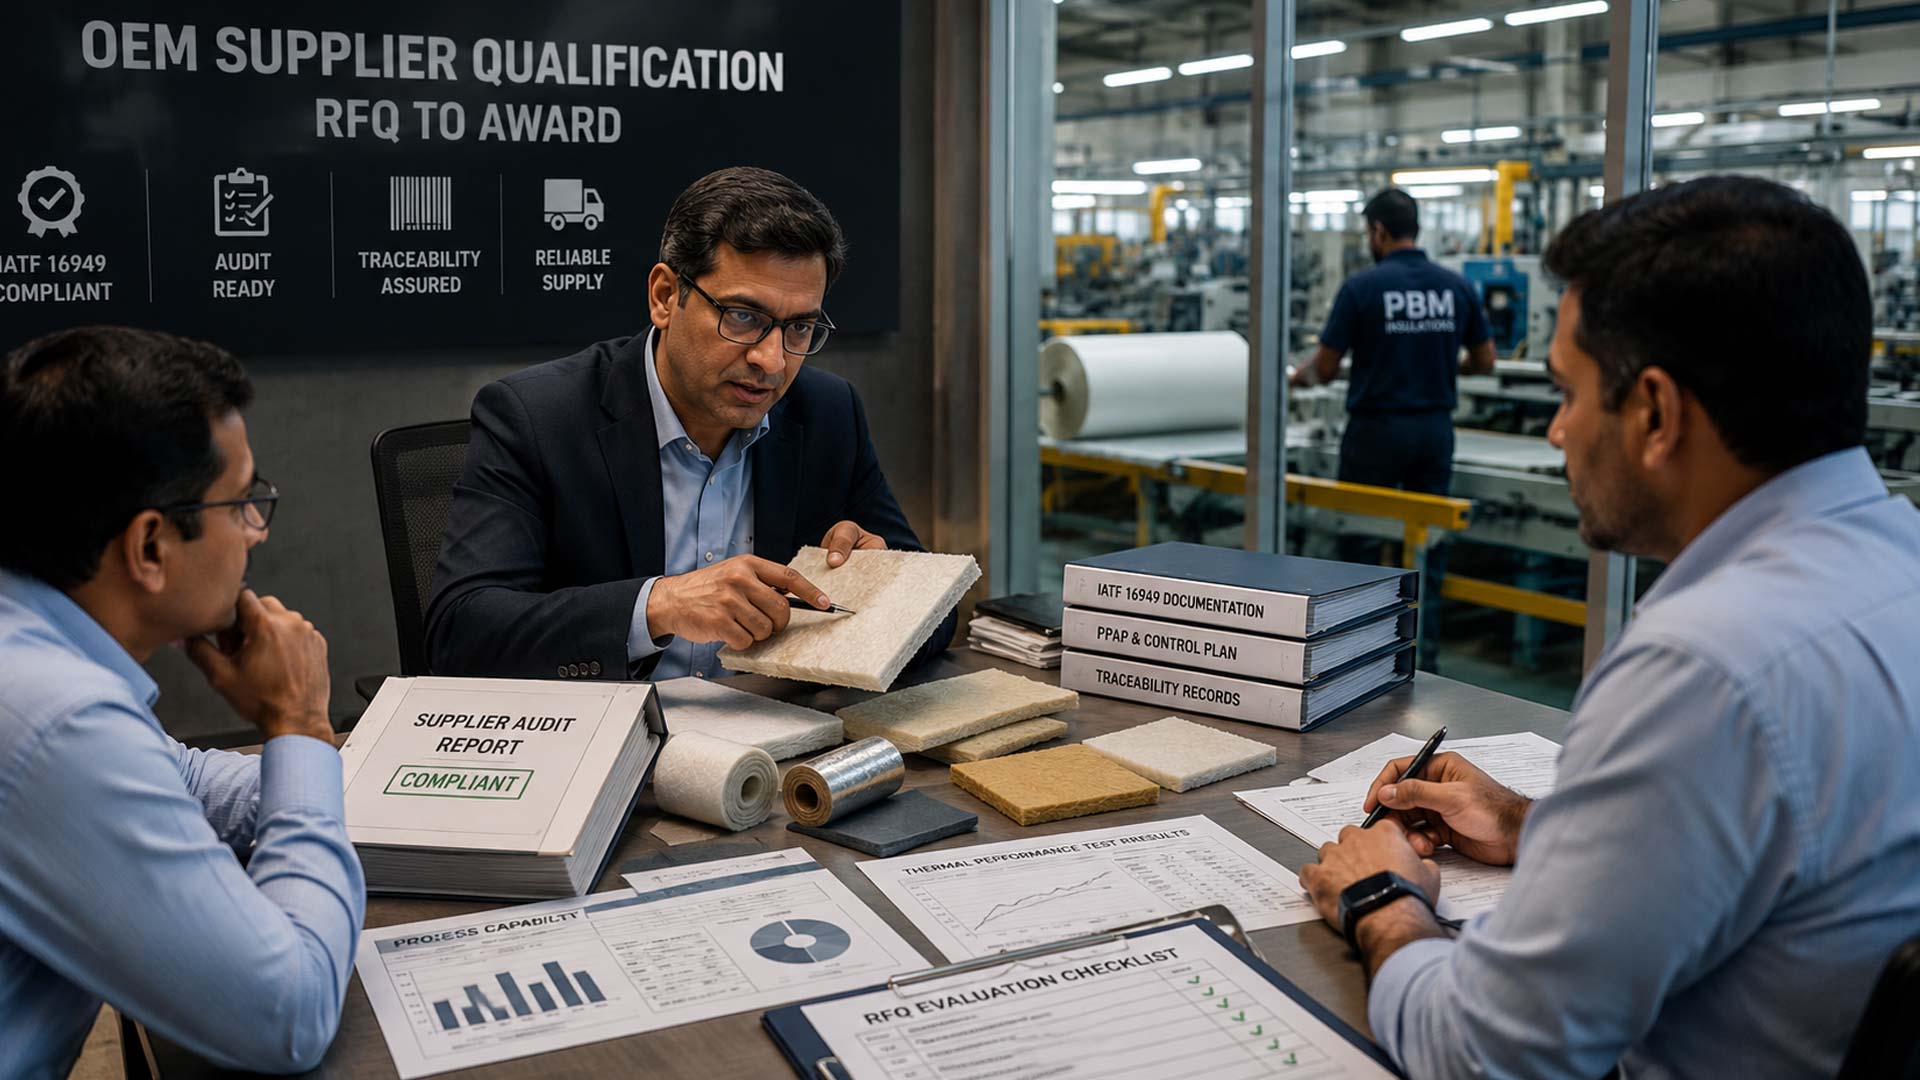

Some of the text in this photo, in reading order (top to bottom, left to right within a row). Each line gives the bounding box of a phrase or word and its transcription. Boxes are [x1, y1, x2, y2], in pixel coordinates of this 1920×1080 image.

[82, 21, 783, 92] OEM SUPPLIER QUALIFICATION
[316, 98, 621, 143] RFQ TO AWARD
[48, 255, 106, 272] 16949
[215, 253, 271, 270] AUDIT
[358, 251, 480, 268] TRACEABILITY
[536, 249, 610, 266] RELIABLE
[214, 280, 275, 297] READY
[381, 276, 461, 294] ASSURED
[543, 274, 603, 290] SUPPLY
[1383, 289, 1455, 320] PBM
[1097, 583, 1264, 619] IATF 16949 DOCUMENTATION
[1097, 626, 1238, 660] PPAP & CONTROL PLAN
[1096, 669, 1241, 706] TRACEABILITY RECORDS
[414, 713, 576, 732] SUPPLIER AUDIT
[436, 737, 524, 754] REPORT
[400, 771, 520, 793] COMPLIANT
[902, 860, 972, 877] THERMAL
[1083, 839, 1118, 851] TEST
[863, 947, 1180, 1026] RFQ EVALUATION CHECKLIST
